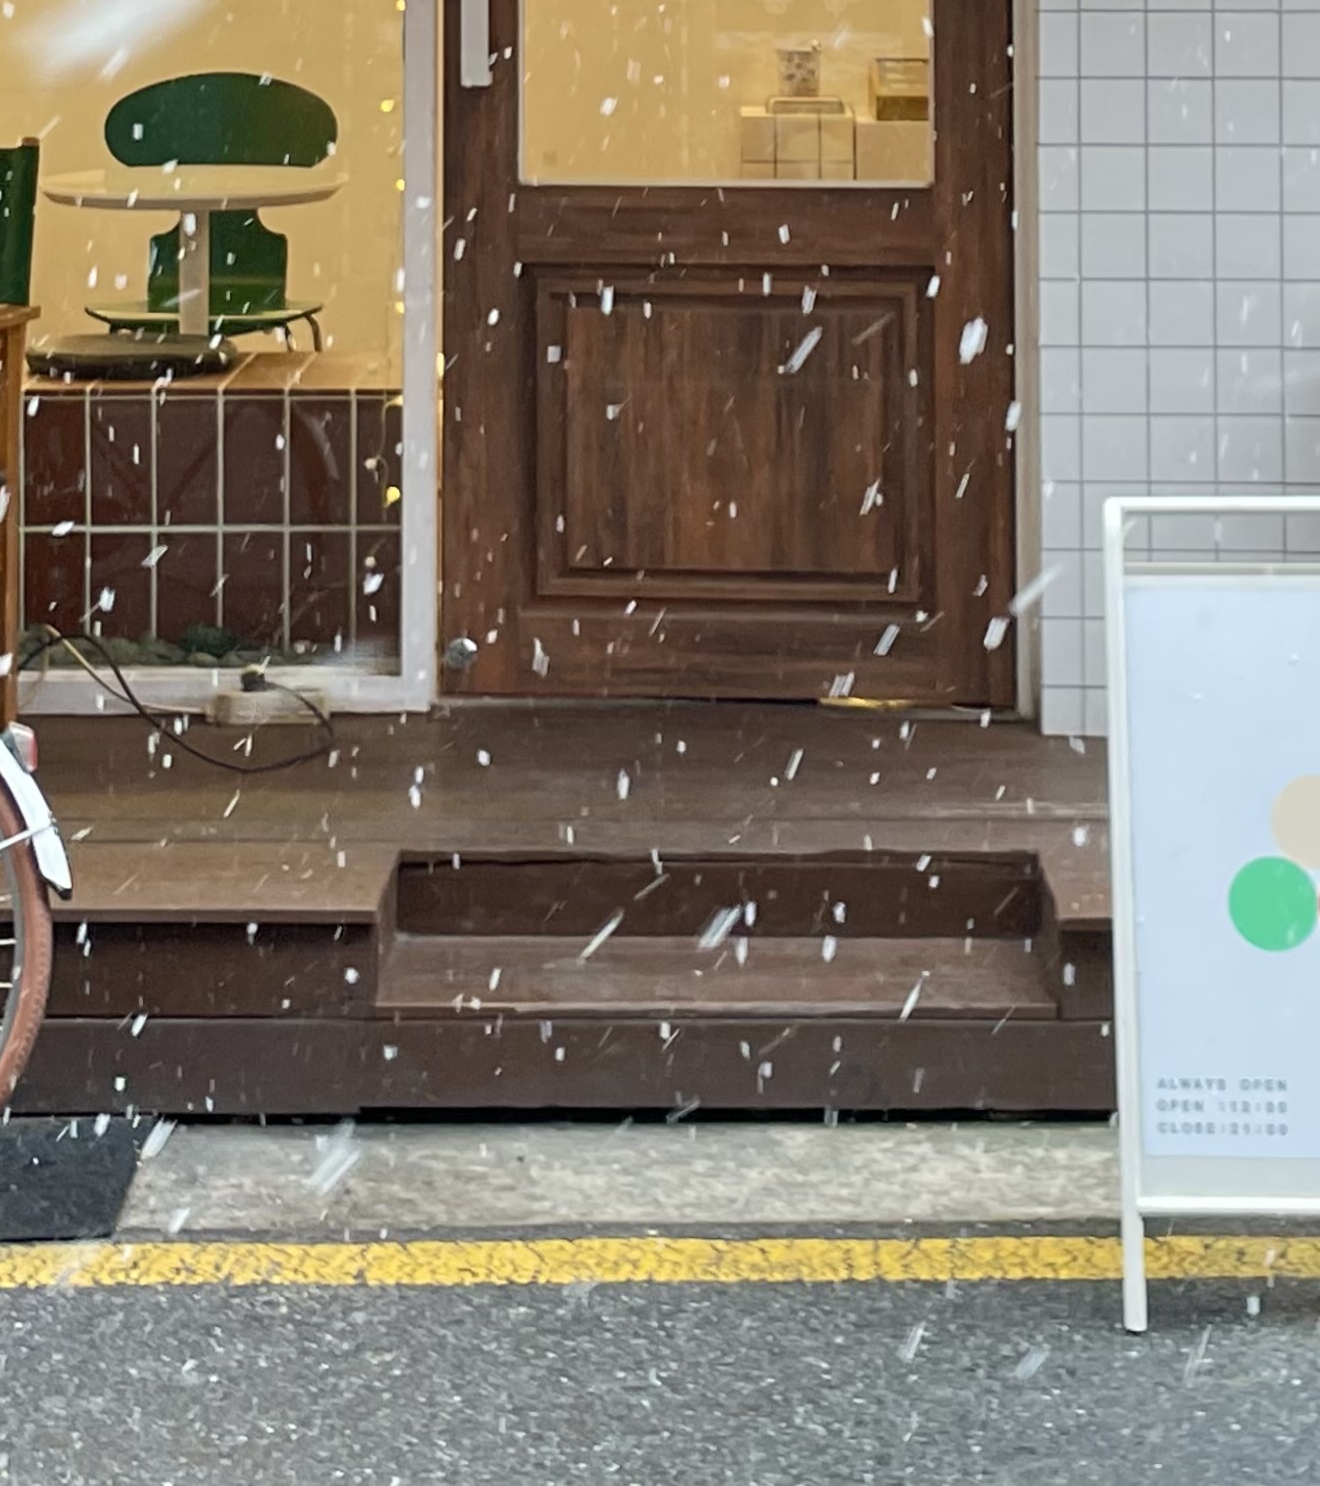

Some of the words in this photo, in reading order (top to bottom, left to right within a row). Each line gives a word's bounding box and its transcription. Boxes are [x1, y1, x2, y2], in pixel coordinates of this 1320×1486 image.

[1156, 1077, 1227, 1091] ALWAYS
[1239, 1077, 1288, 1092] OPEN
[1155, 1099, 1205, 1112] OPEN
